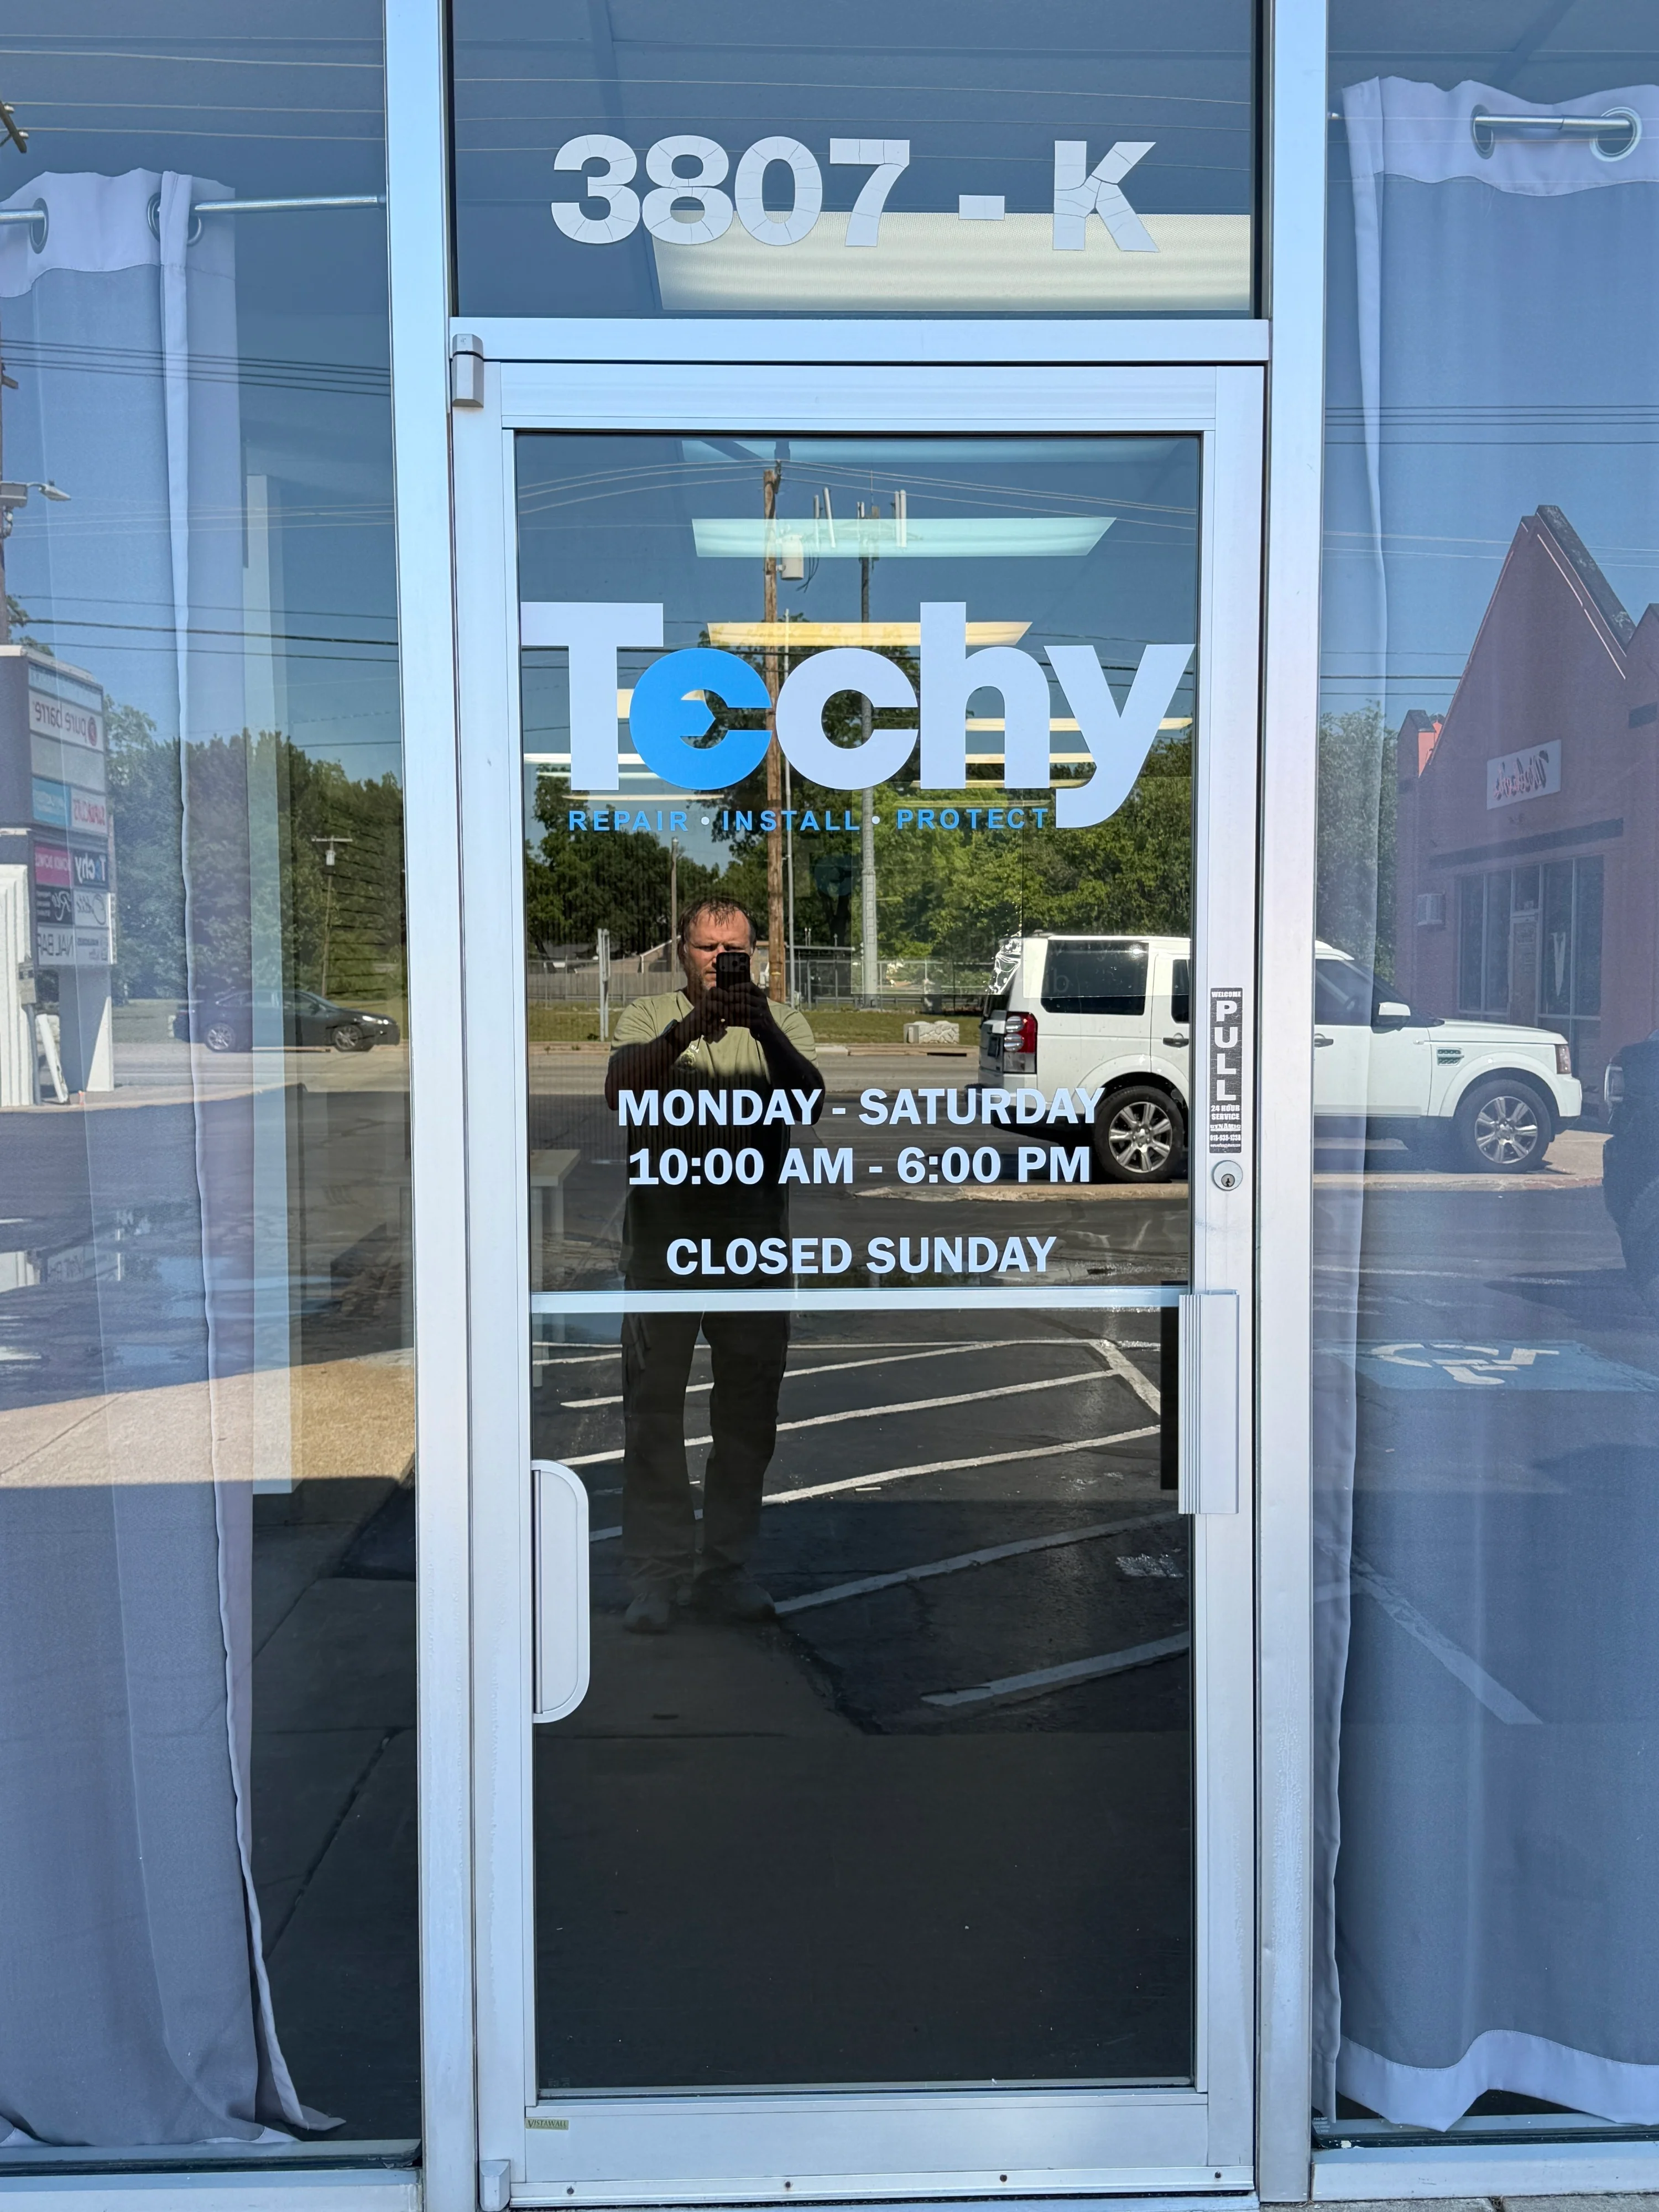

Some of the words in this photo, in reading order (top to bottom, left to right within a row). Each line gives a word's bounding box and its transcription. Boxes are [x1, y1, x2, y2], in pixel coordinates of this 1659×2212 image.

[551, 134, 910, 247] 3807
[1052, 140, 1160, 253] K
[520, 602, 1195, 828] Techy
[568, 810, 689, 832] REPAIR
[723, 809, 860, 832] INSTALL
[896, 807, 1050, 830] PROTECT
[1214, 1000, 1238, 1101] PULL
[618, 1089, 822, 1126] MONDAY
[858, 1088, 1106, 1126] SATURDAY
[628, 1147, 764, 1186] 10:00
[778, 1147, 854, 1185] AM
[896, 1146, 1001, 1185] 6:00
[1018, 1146, 1092, 1183] PM
[666, 1237, 853, 1275] CLOSED
[865, 1236, 1057, 1274] SUNDAY
[528, 2120, 567, 2128] VISTAWALL
